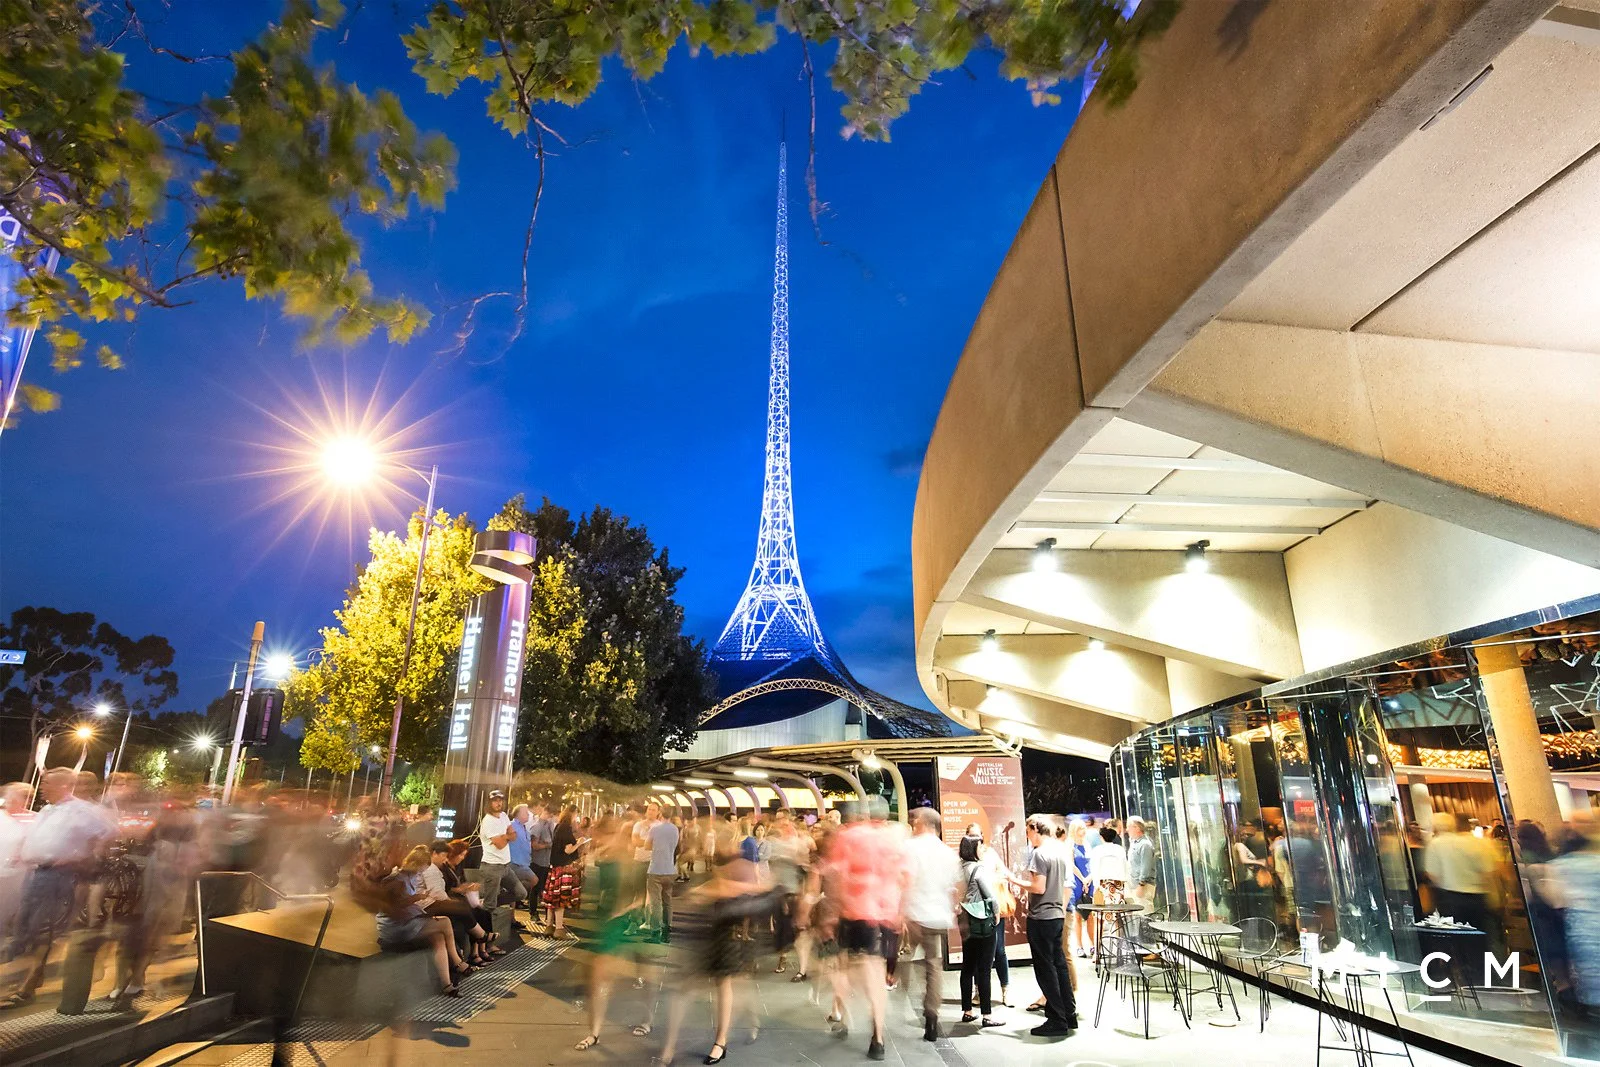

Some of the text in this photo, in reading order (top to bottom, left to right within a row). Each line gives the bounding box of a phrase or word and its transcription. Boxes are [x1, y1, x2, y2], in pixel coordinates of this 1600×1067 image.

[450, 616, 483, 751] Hamer Hall
[497, 619, 525, 752] Hamer Hall
[970, 775, 996, 785] VAULT
[976, 767, 1004, 776] MUSIC
